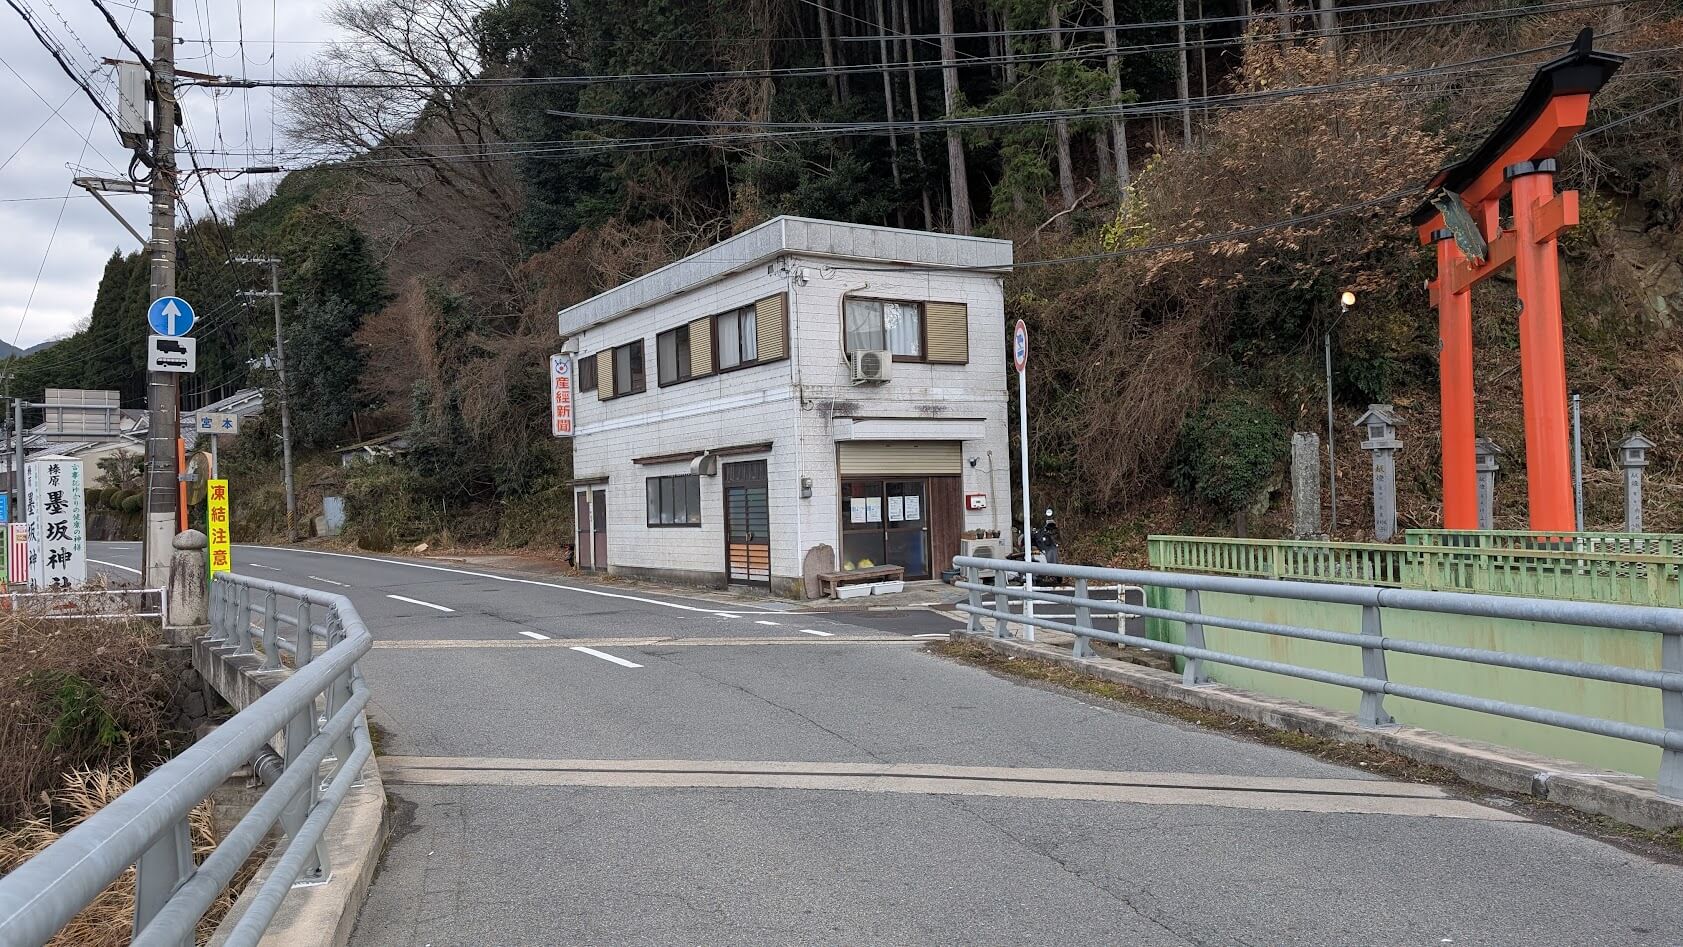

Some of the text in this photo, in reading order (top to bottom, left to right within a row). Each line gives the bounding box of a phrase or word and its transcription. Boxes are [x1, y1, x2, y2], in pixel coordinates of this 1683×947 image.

[201, 416, 233, 429] 宮本
[210, 485, 228, 566] 凍結注意
